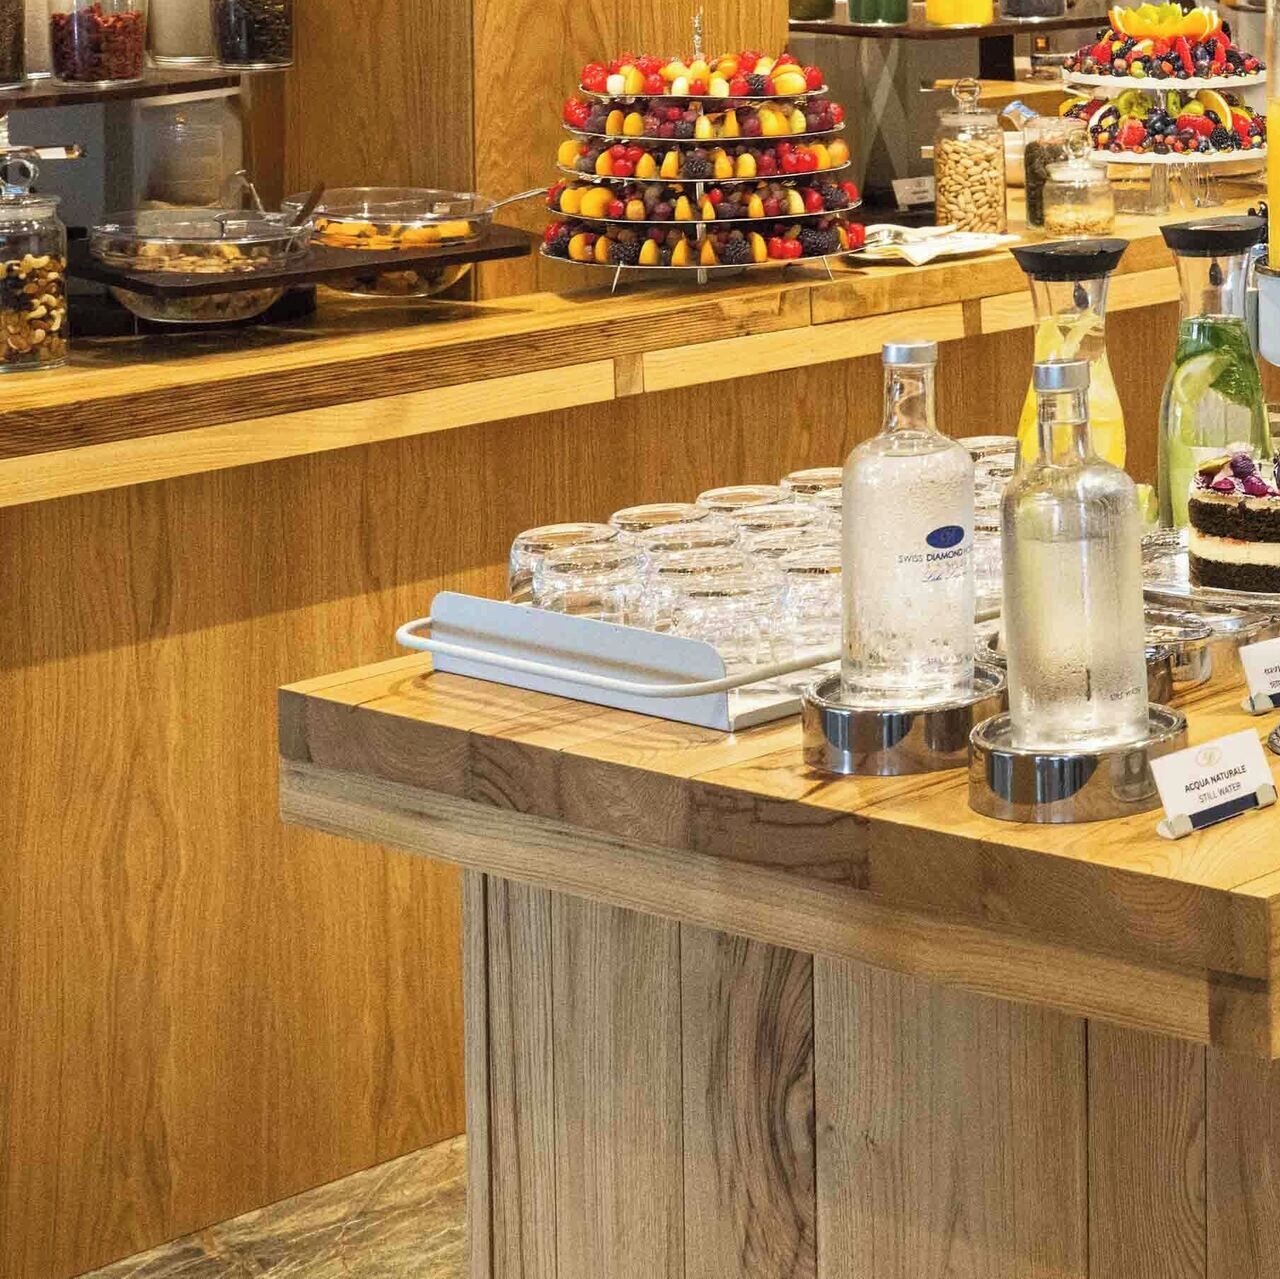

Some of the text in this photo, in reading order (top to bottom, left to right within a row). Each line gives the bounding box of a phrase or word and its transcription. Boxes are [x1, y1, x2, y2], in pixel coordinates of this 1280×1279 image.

[926, 548, 963, 562] DIAMOND
[1185, 764, 1246, 793] ACQUA NATURALE
[1199, 781, 1241, 803] STILL WATER
